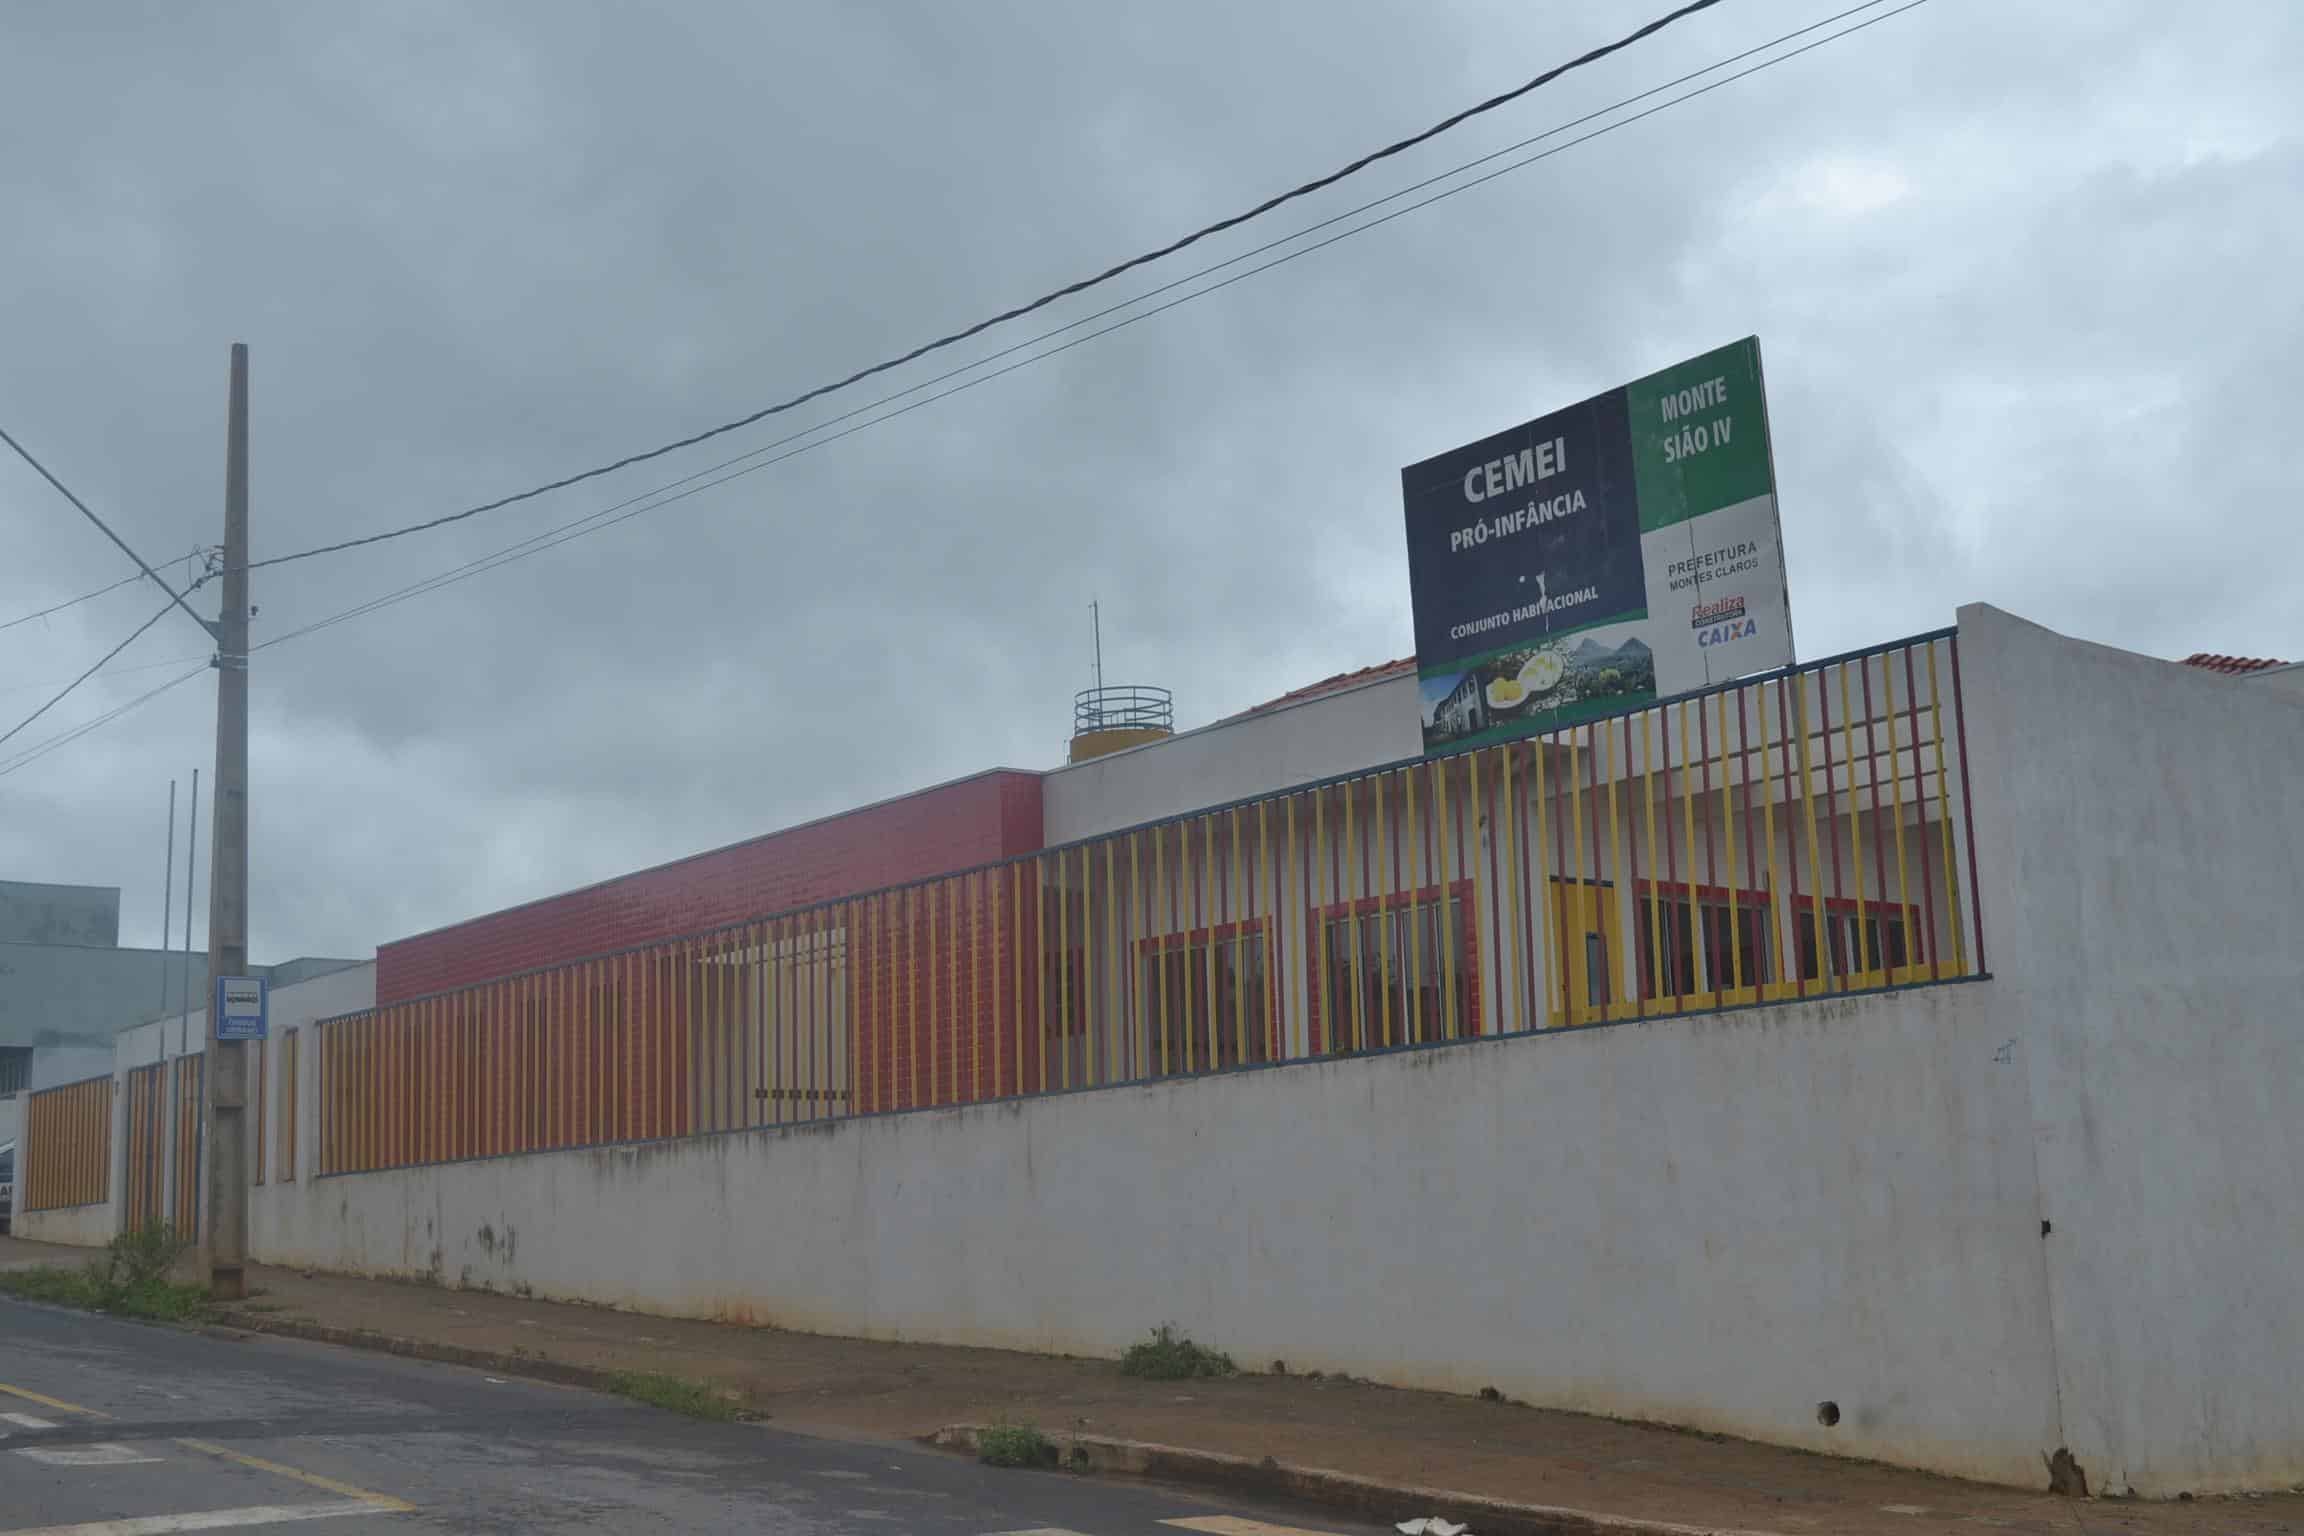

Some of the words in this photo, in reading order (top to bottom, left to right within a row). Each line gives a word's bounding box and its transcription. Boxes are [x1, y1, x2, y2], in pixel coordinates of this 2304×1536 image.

[1661, 376, 1727, 423] MONTE
[1664, 424, 1708, 463] SIÃO
[1713, 416, 1731, 446] IV
[1464, 436, 1566, 503] CEMEI
[1451, 489, 1587, 552] PRÓ-INFÂNCIA
[1668, 540, 1757, 577] PREFEITURA
[1669, 570, 1713, 592] MONTES
[1715, 559, 1759, 578] CLAROS
[1450, 612, 1510, 639] CONJUNTO
[1692, 596, 1745, 620] Realiza
[1698, 619, 1756, 647] CAIXA
